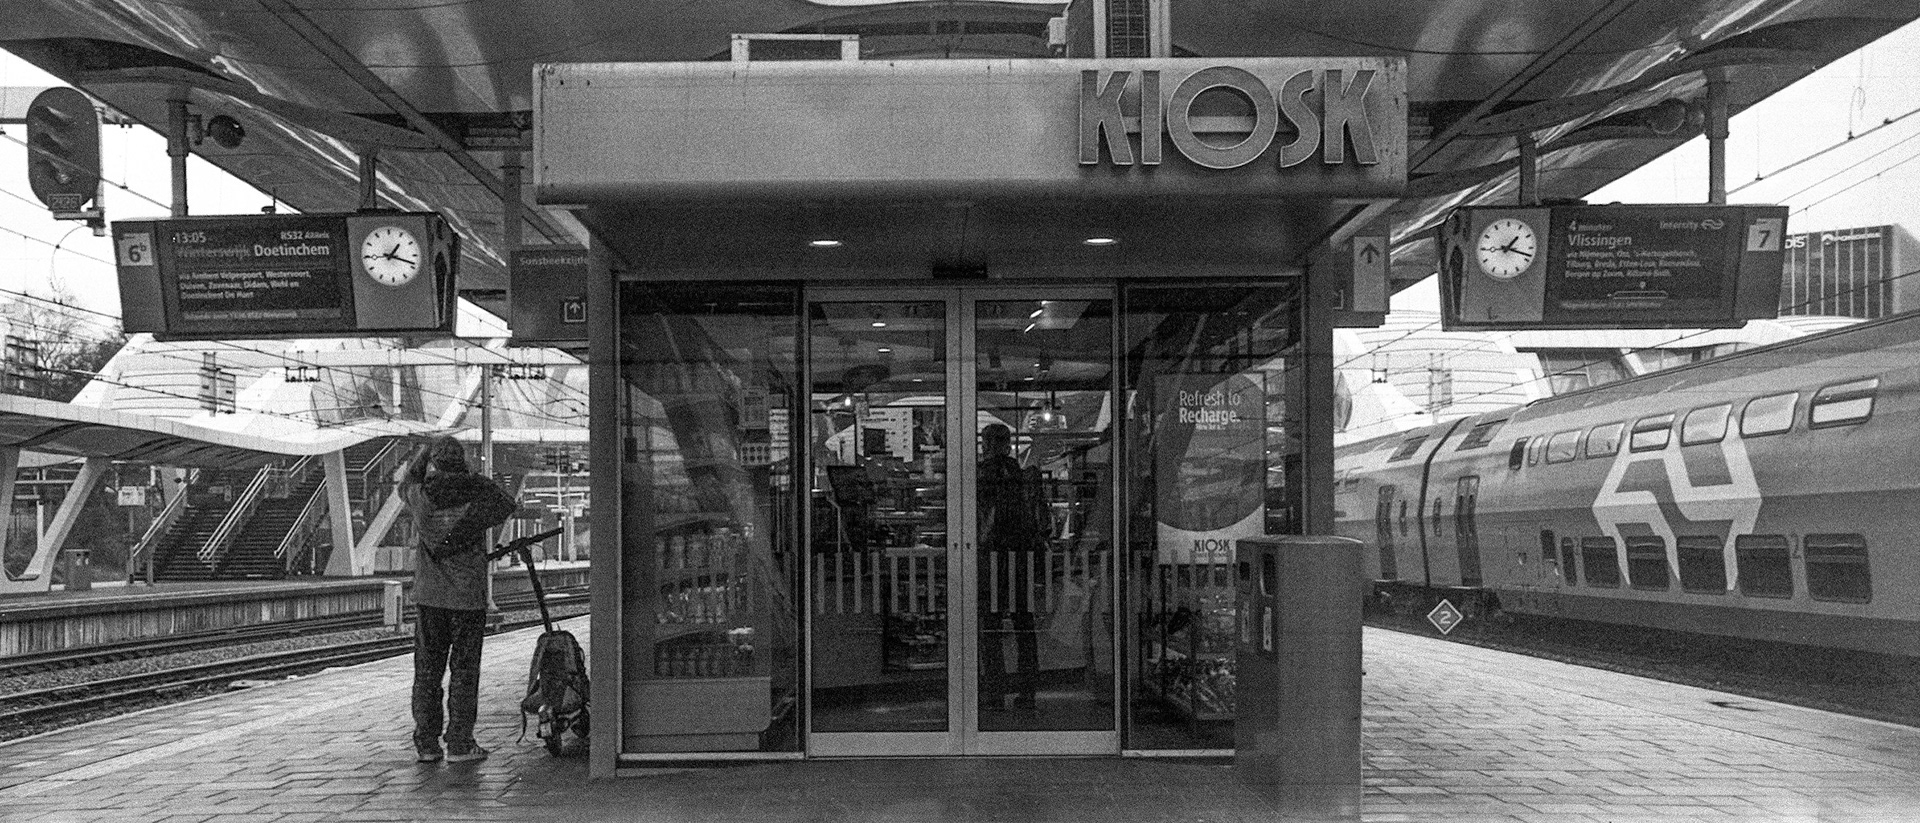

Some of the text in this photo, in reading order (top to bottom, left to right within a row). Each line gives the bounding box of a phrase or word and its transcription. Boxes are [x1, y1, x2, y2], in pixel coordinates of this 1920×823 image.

[1079, 65, 1379, 169] KIOSK
[1569, 221, 1577, 231] 4
[175, 232, 207, 243] 13:05
[280, 231, 303, 240] RS32
[1567, 233, 1632, 249] Vlissingen
[1759, 230, 1770, 248] 7
[254, 243, 330, 256] Doetinchem
[1179, 390, 1240, 406] Refresh to
[1179, 407, 1241, 425] Recharge.
[1194, 539, 1230, 551] KIOSK
[1440, 610, 1451, 624] 2
